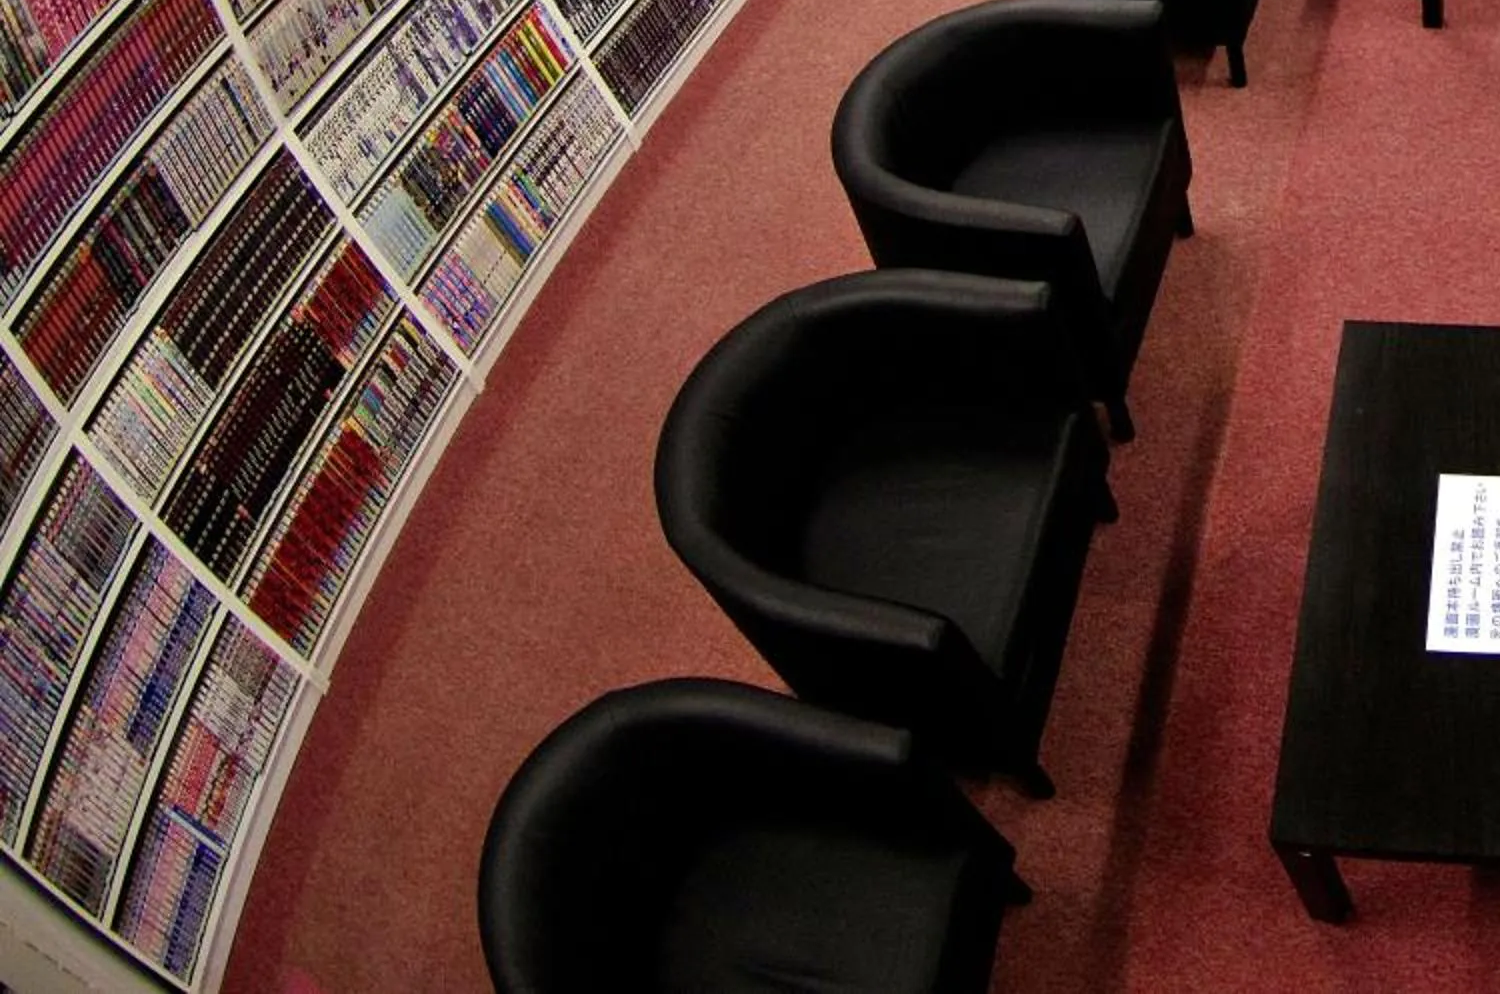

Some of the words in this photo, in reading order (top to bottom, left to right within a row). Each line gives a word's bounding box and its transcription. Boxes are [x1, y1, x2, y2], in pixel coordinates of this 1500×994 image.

[1443, 528, 1465, 639] 漫画本持ち出し禁止
